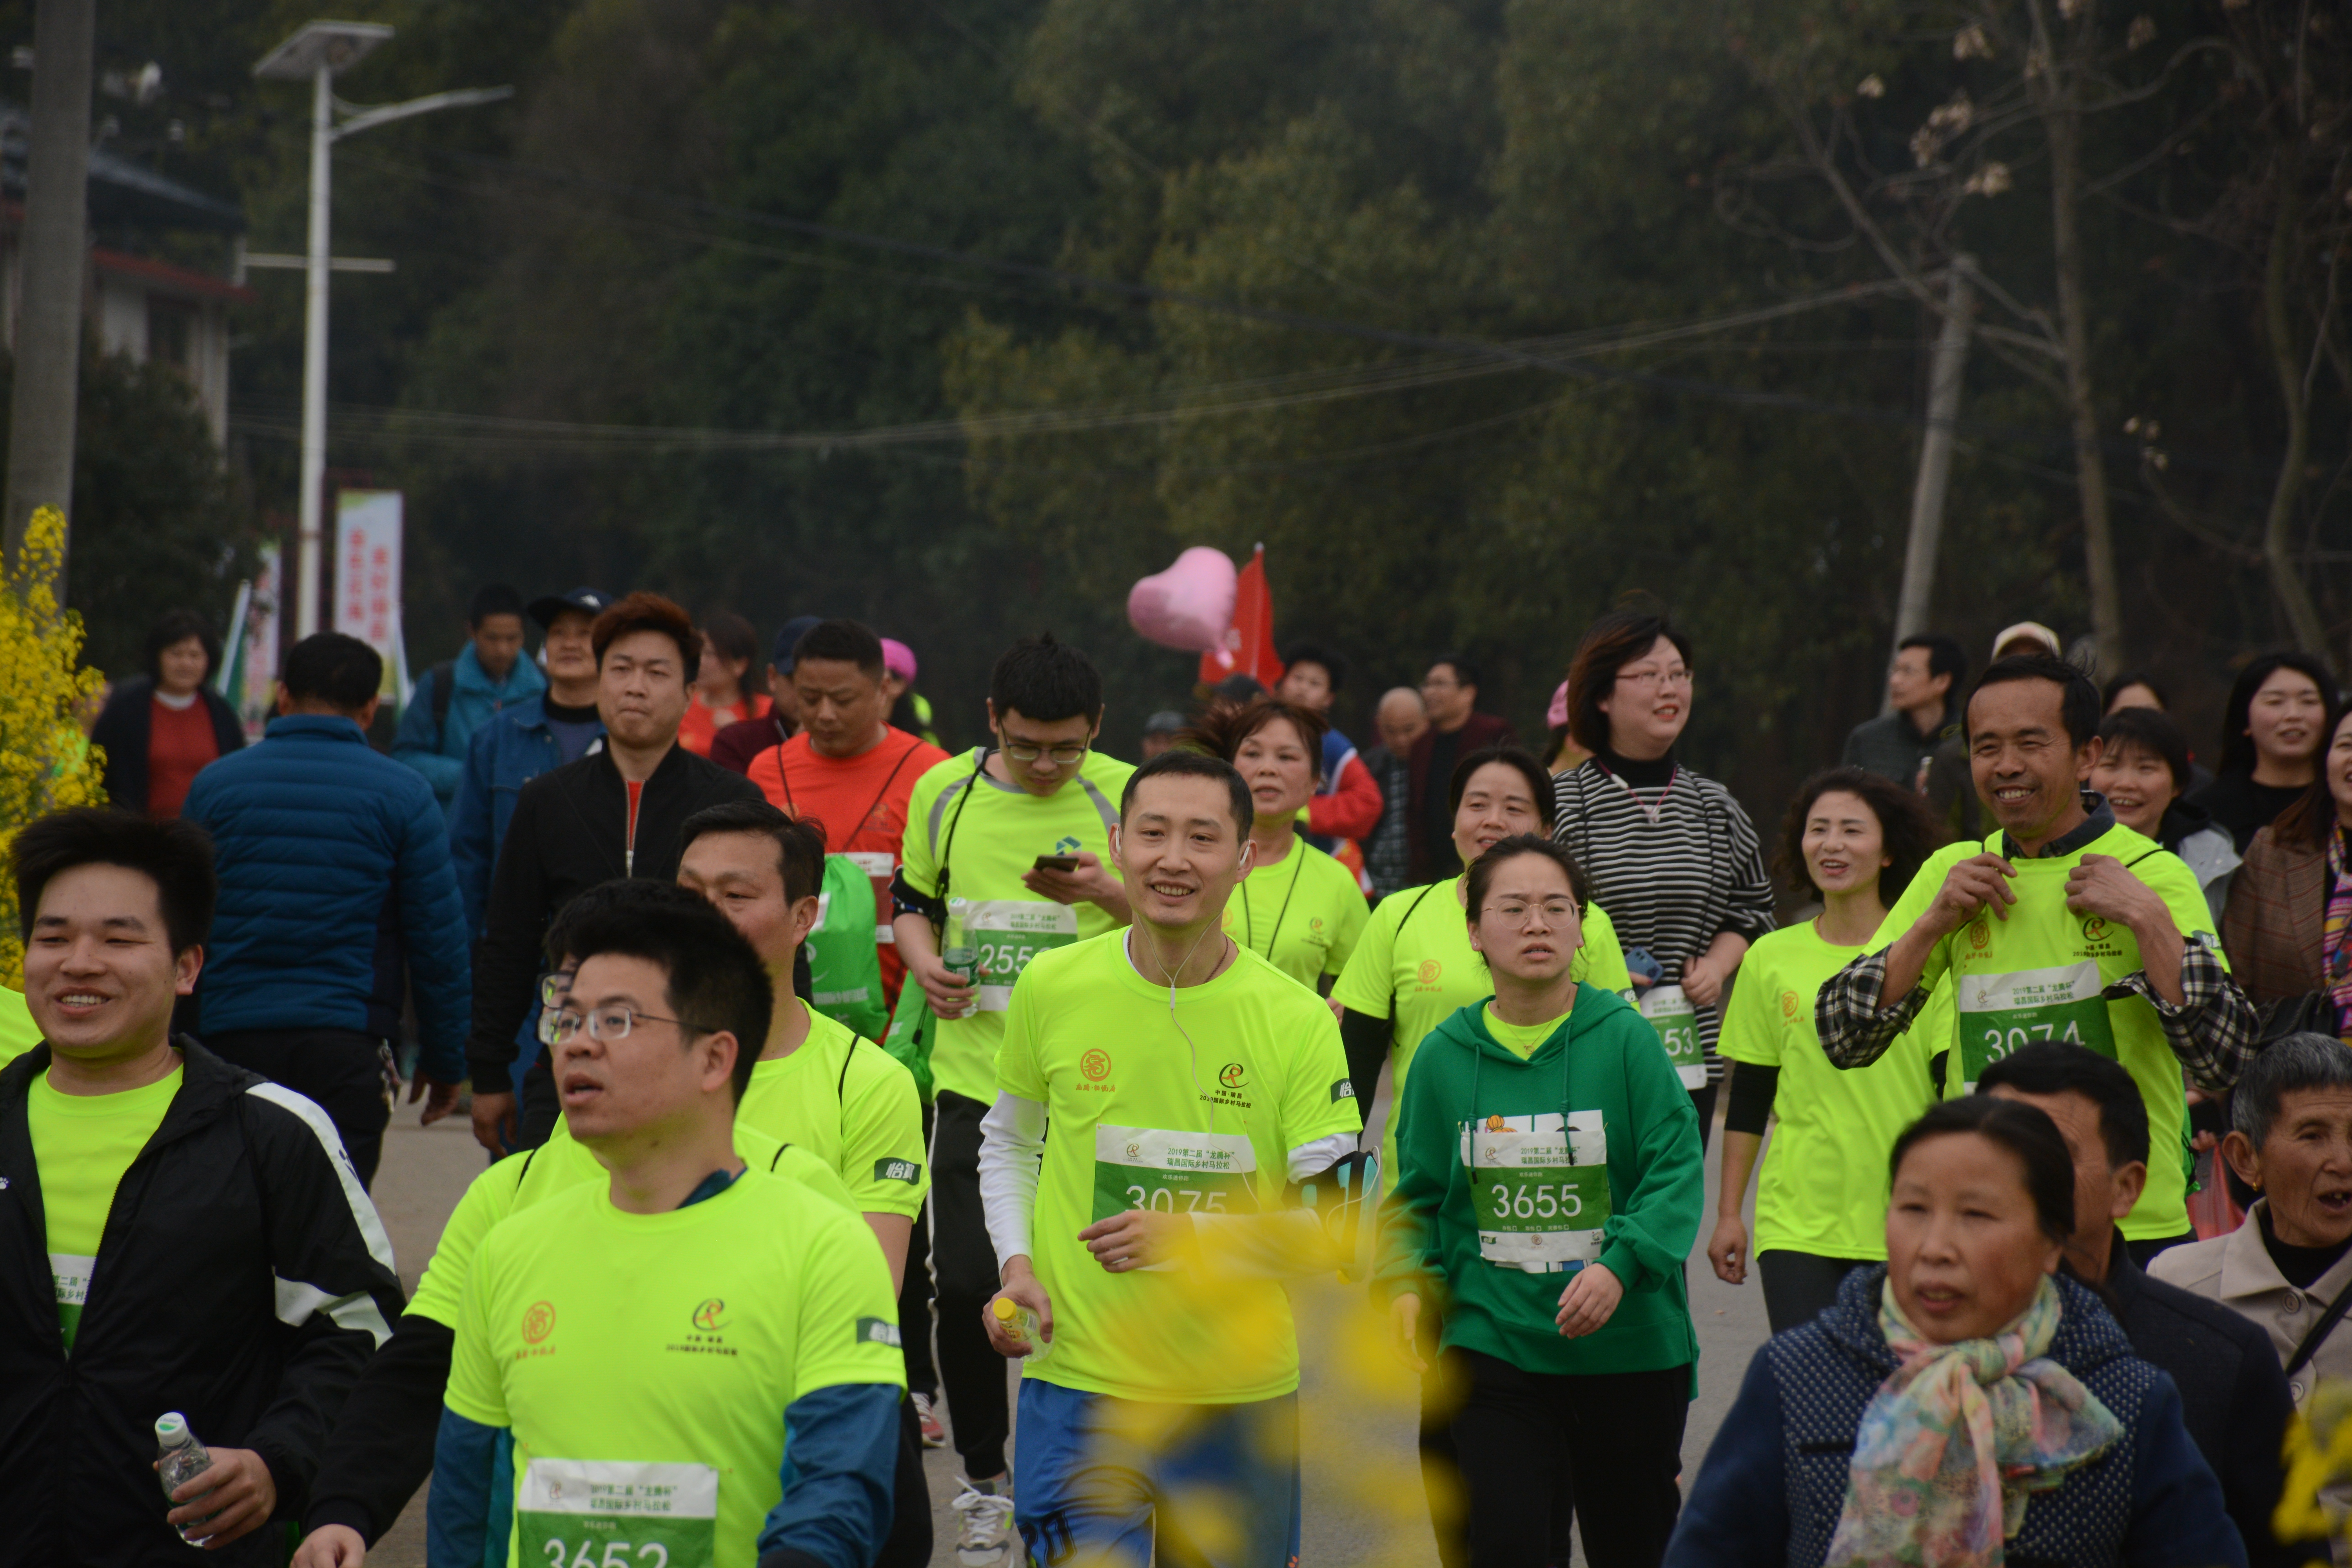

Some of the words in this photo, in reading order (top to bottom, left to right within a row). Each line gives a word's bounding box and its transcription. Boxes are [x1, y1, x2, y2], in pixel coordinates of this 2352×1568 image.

[981, 944, 1051, 974] 255
[1200, 1095, 1251, 1109] 2019国际乡村马拉松
[1215, 1089, 1242, 1099] 中国·瑞昌
[1167, 1158, 1230, 1169] 瑞昌国际乡村马拉松
[1125, 1185, 1227, 1214] 3075
[1492, 1184, 1582, 1218] 3655
[544, 1538, 668, 1568] 3652
